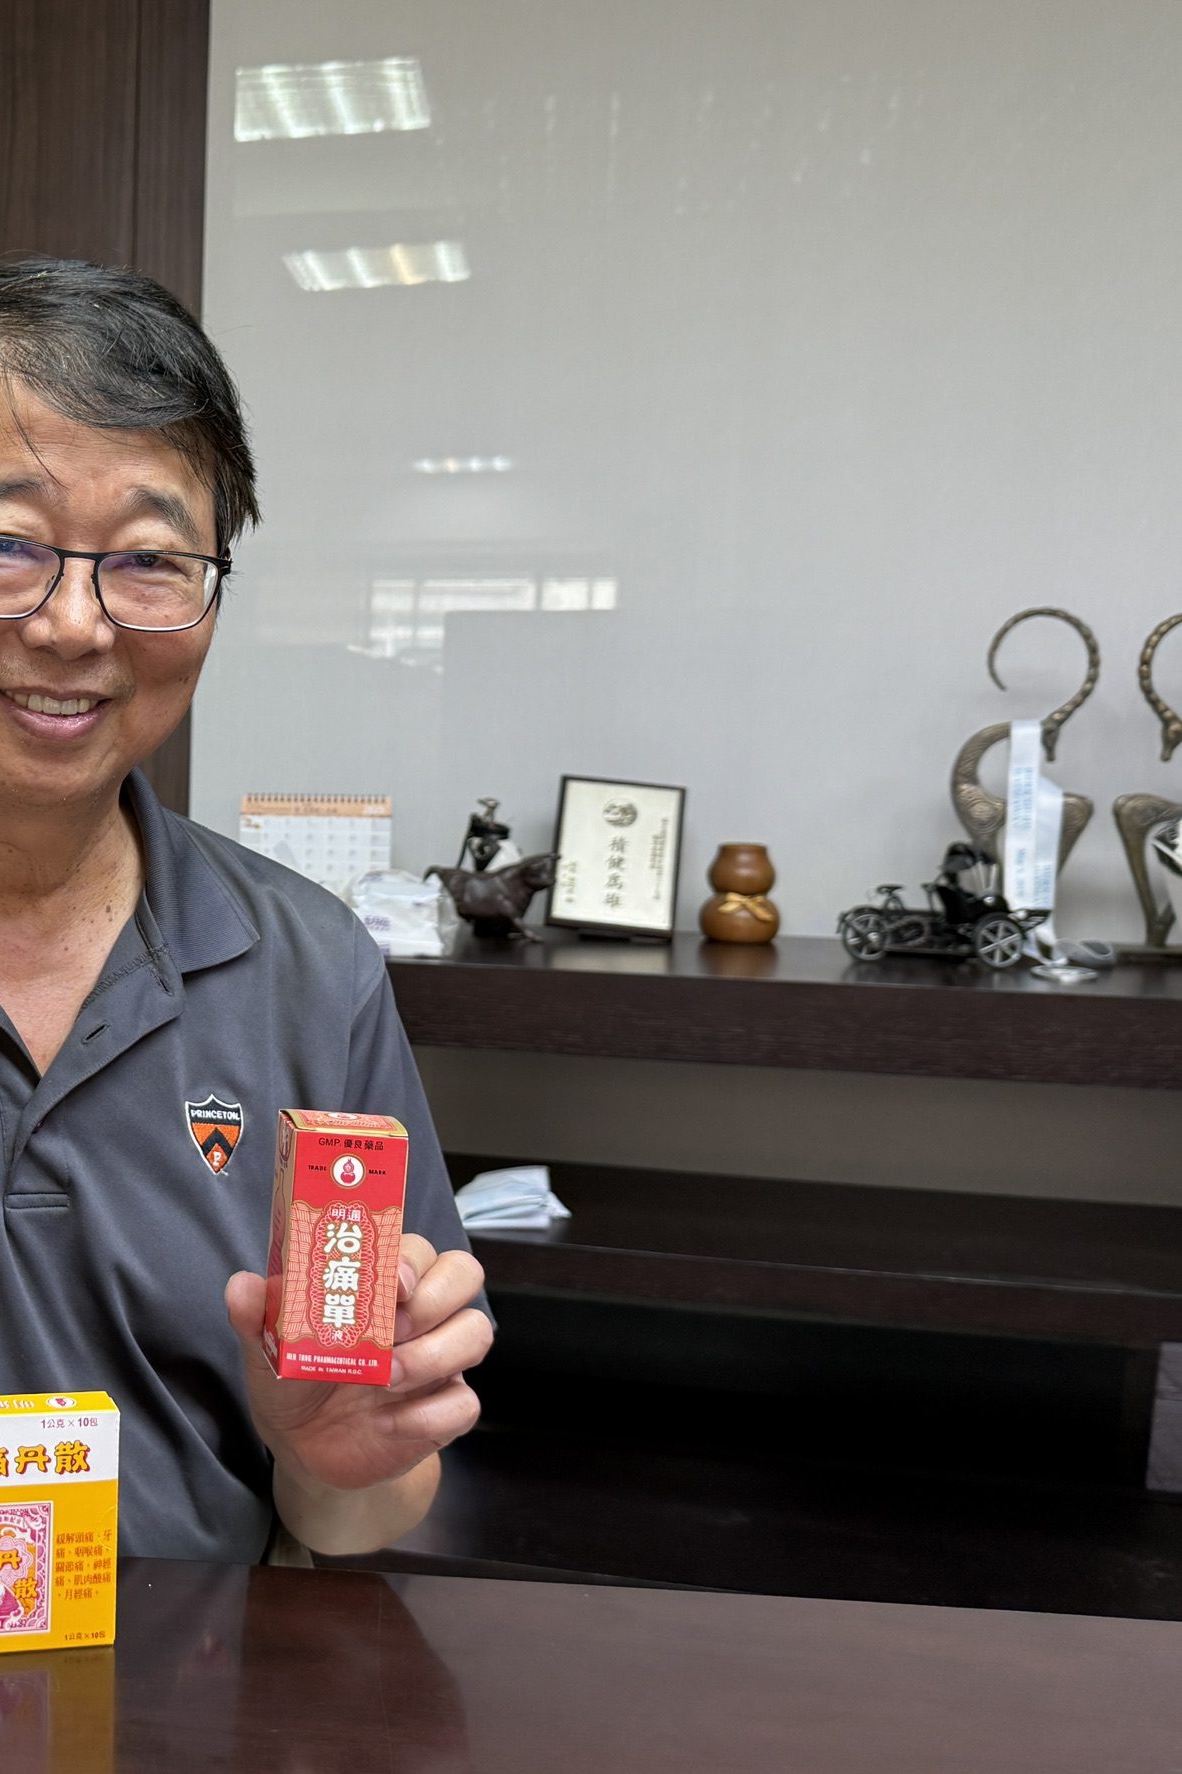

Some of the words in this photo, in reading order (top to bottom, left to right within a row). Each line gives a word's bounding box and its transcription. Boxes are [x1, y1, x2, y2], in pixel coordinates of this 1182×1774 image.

[190, 1109, 241, 1121] PRINCETON
[318, 1137, 341, 1147] GMP
[344, 1138, 384, 1151] 優良藥品
[213, 1151, 222, 1166] P
[331, 1208, 362, 1222] 明通
[322, 1221, 363, 1329] 治痛單
[14, 1578, 38, 1599] 散
